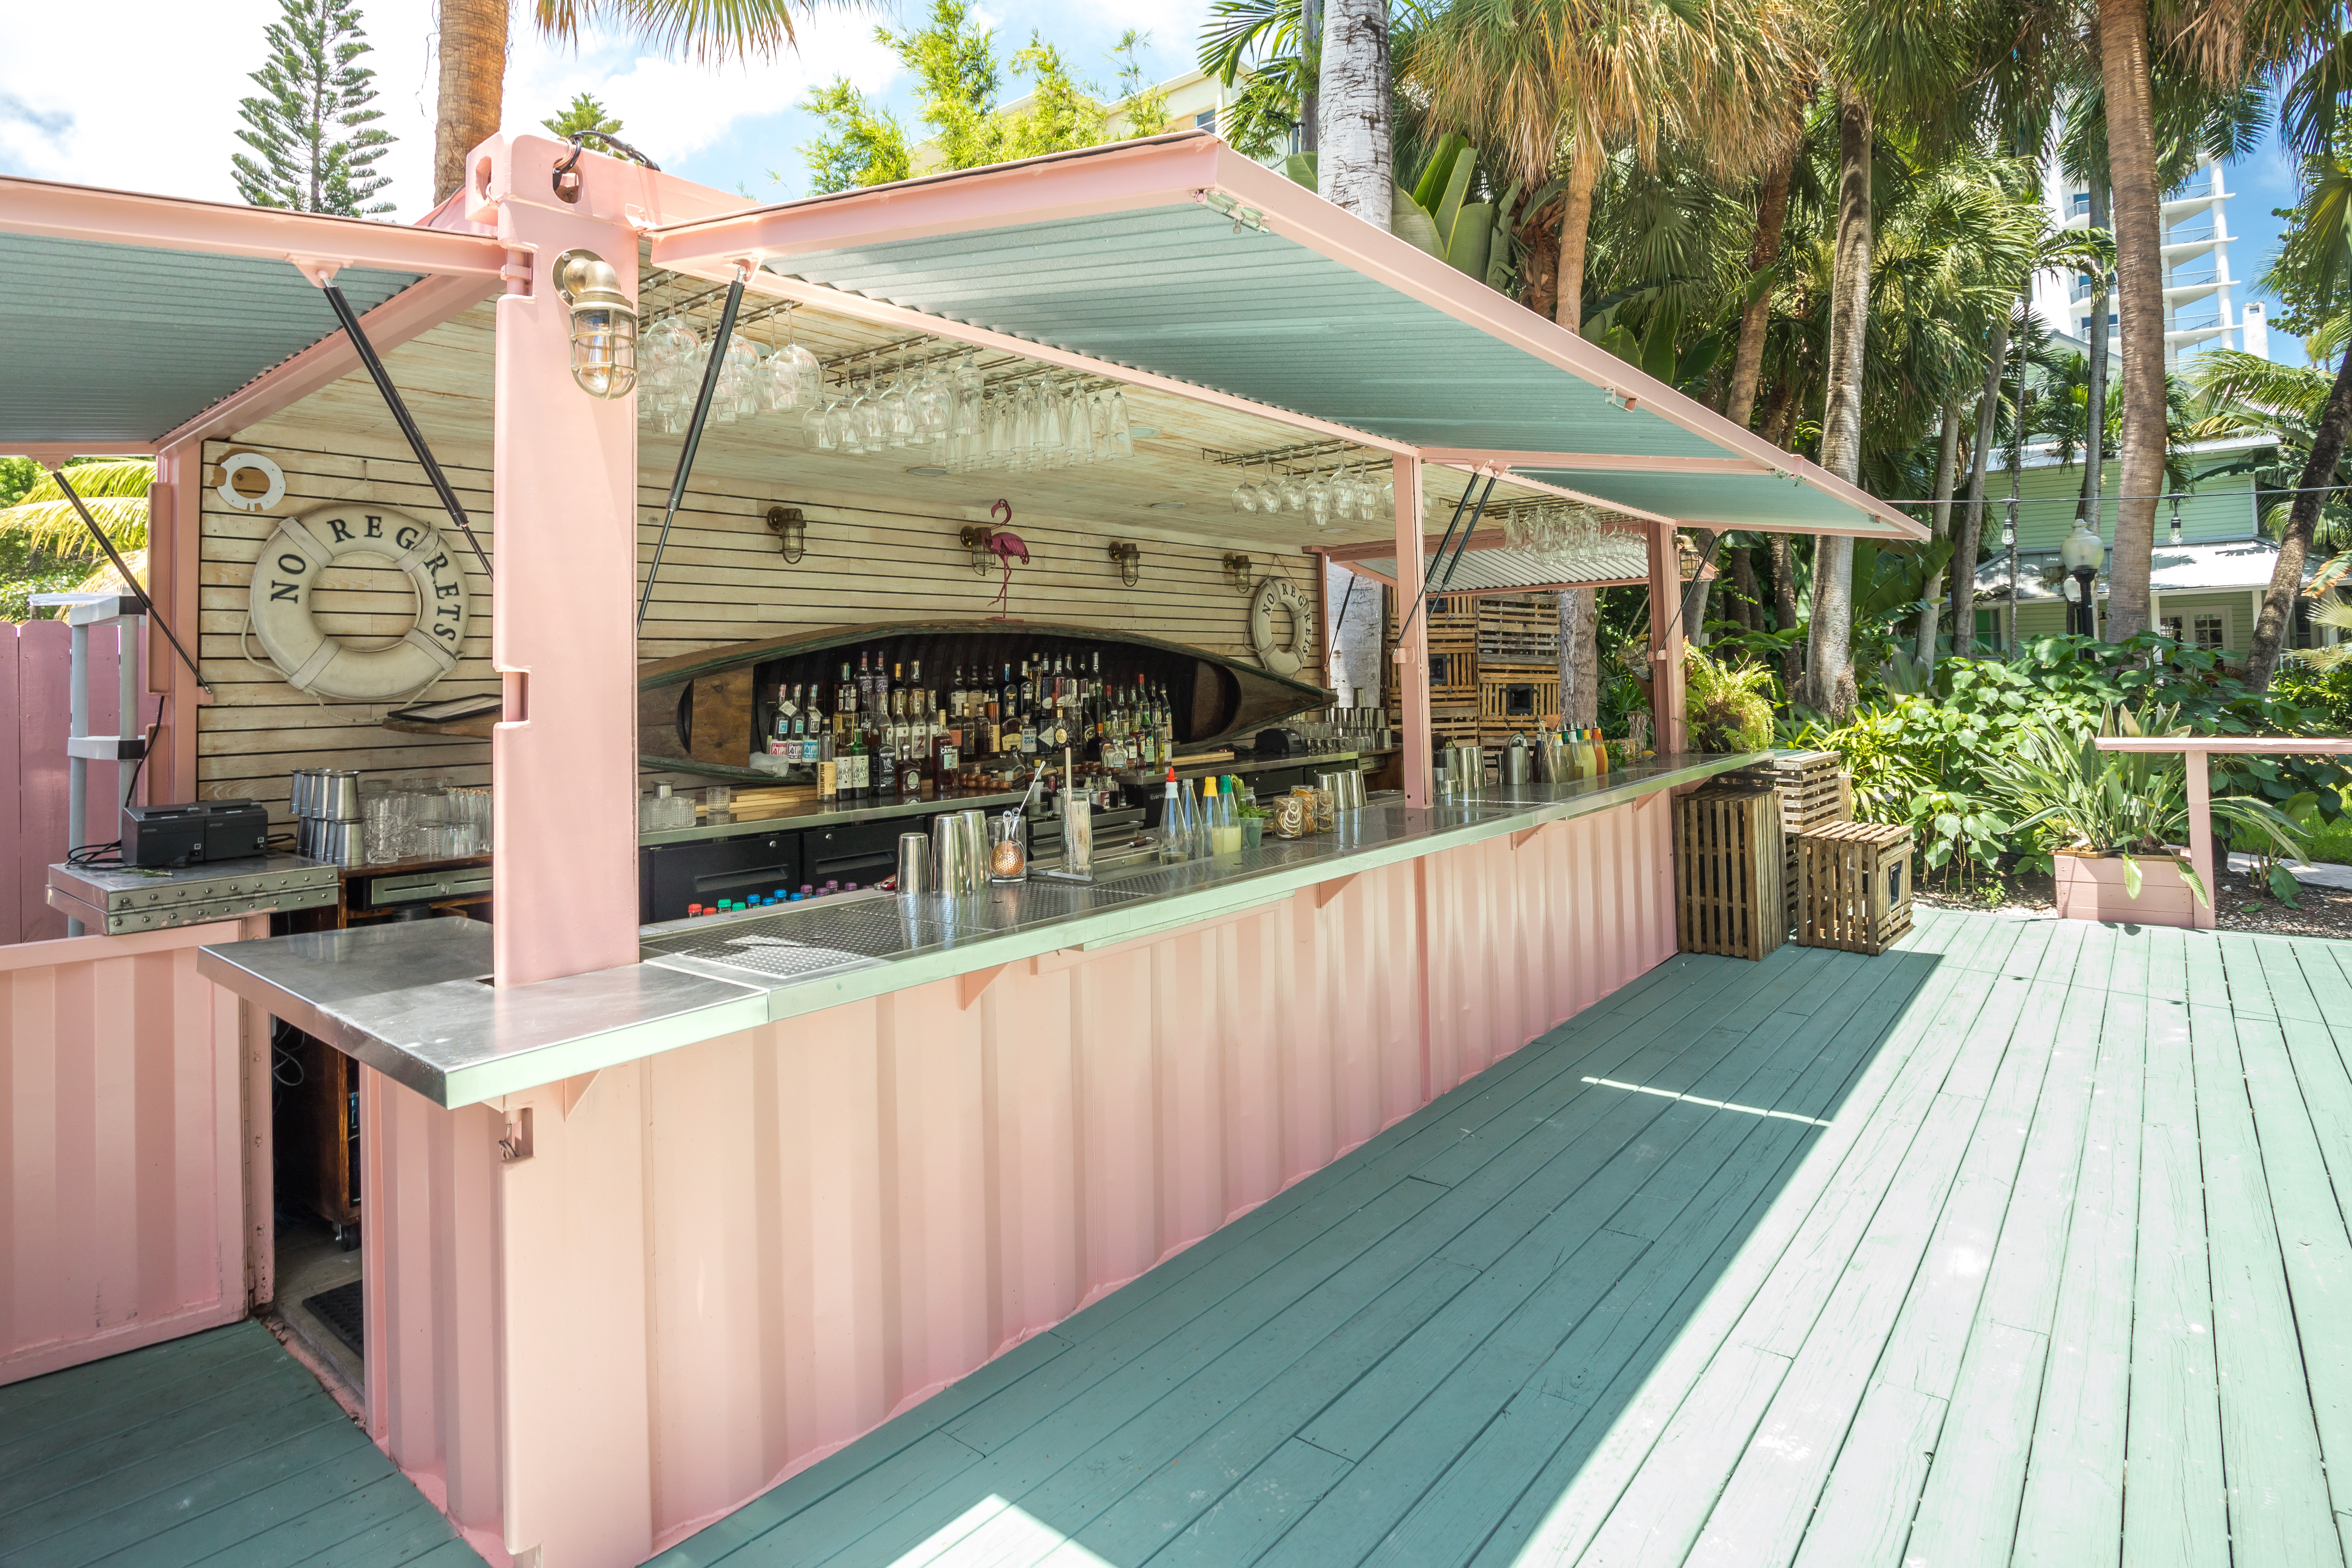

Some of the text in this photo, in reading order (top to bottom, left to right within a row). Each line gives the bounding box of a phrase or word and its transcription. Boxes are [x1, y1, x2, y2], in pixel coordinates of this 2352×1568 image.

[270, 515, 461, 642] NO REGRETS
[1262, 583, 1312, 656] NO REGRETS
[917, 736, 924, 748] 2
